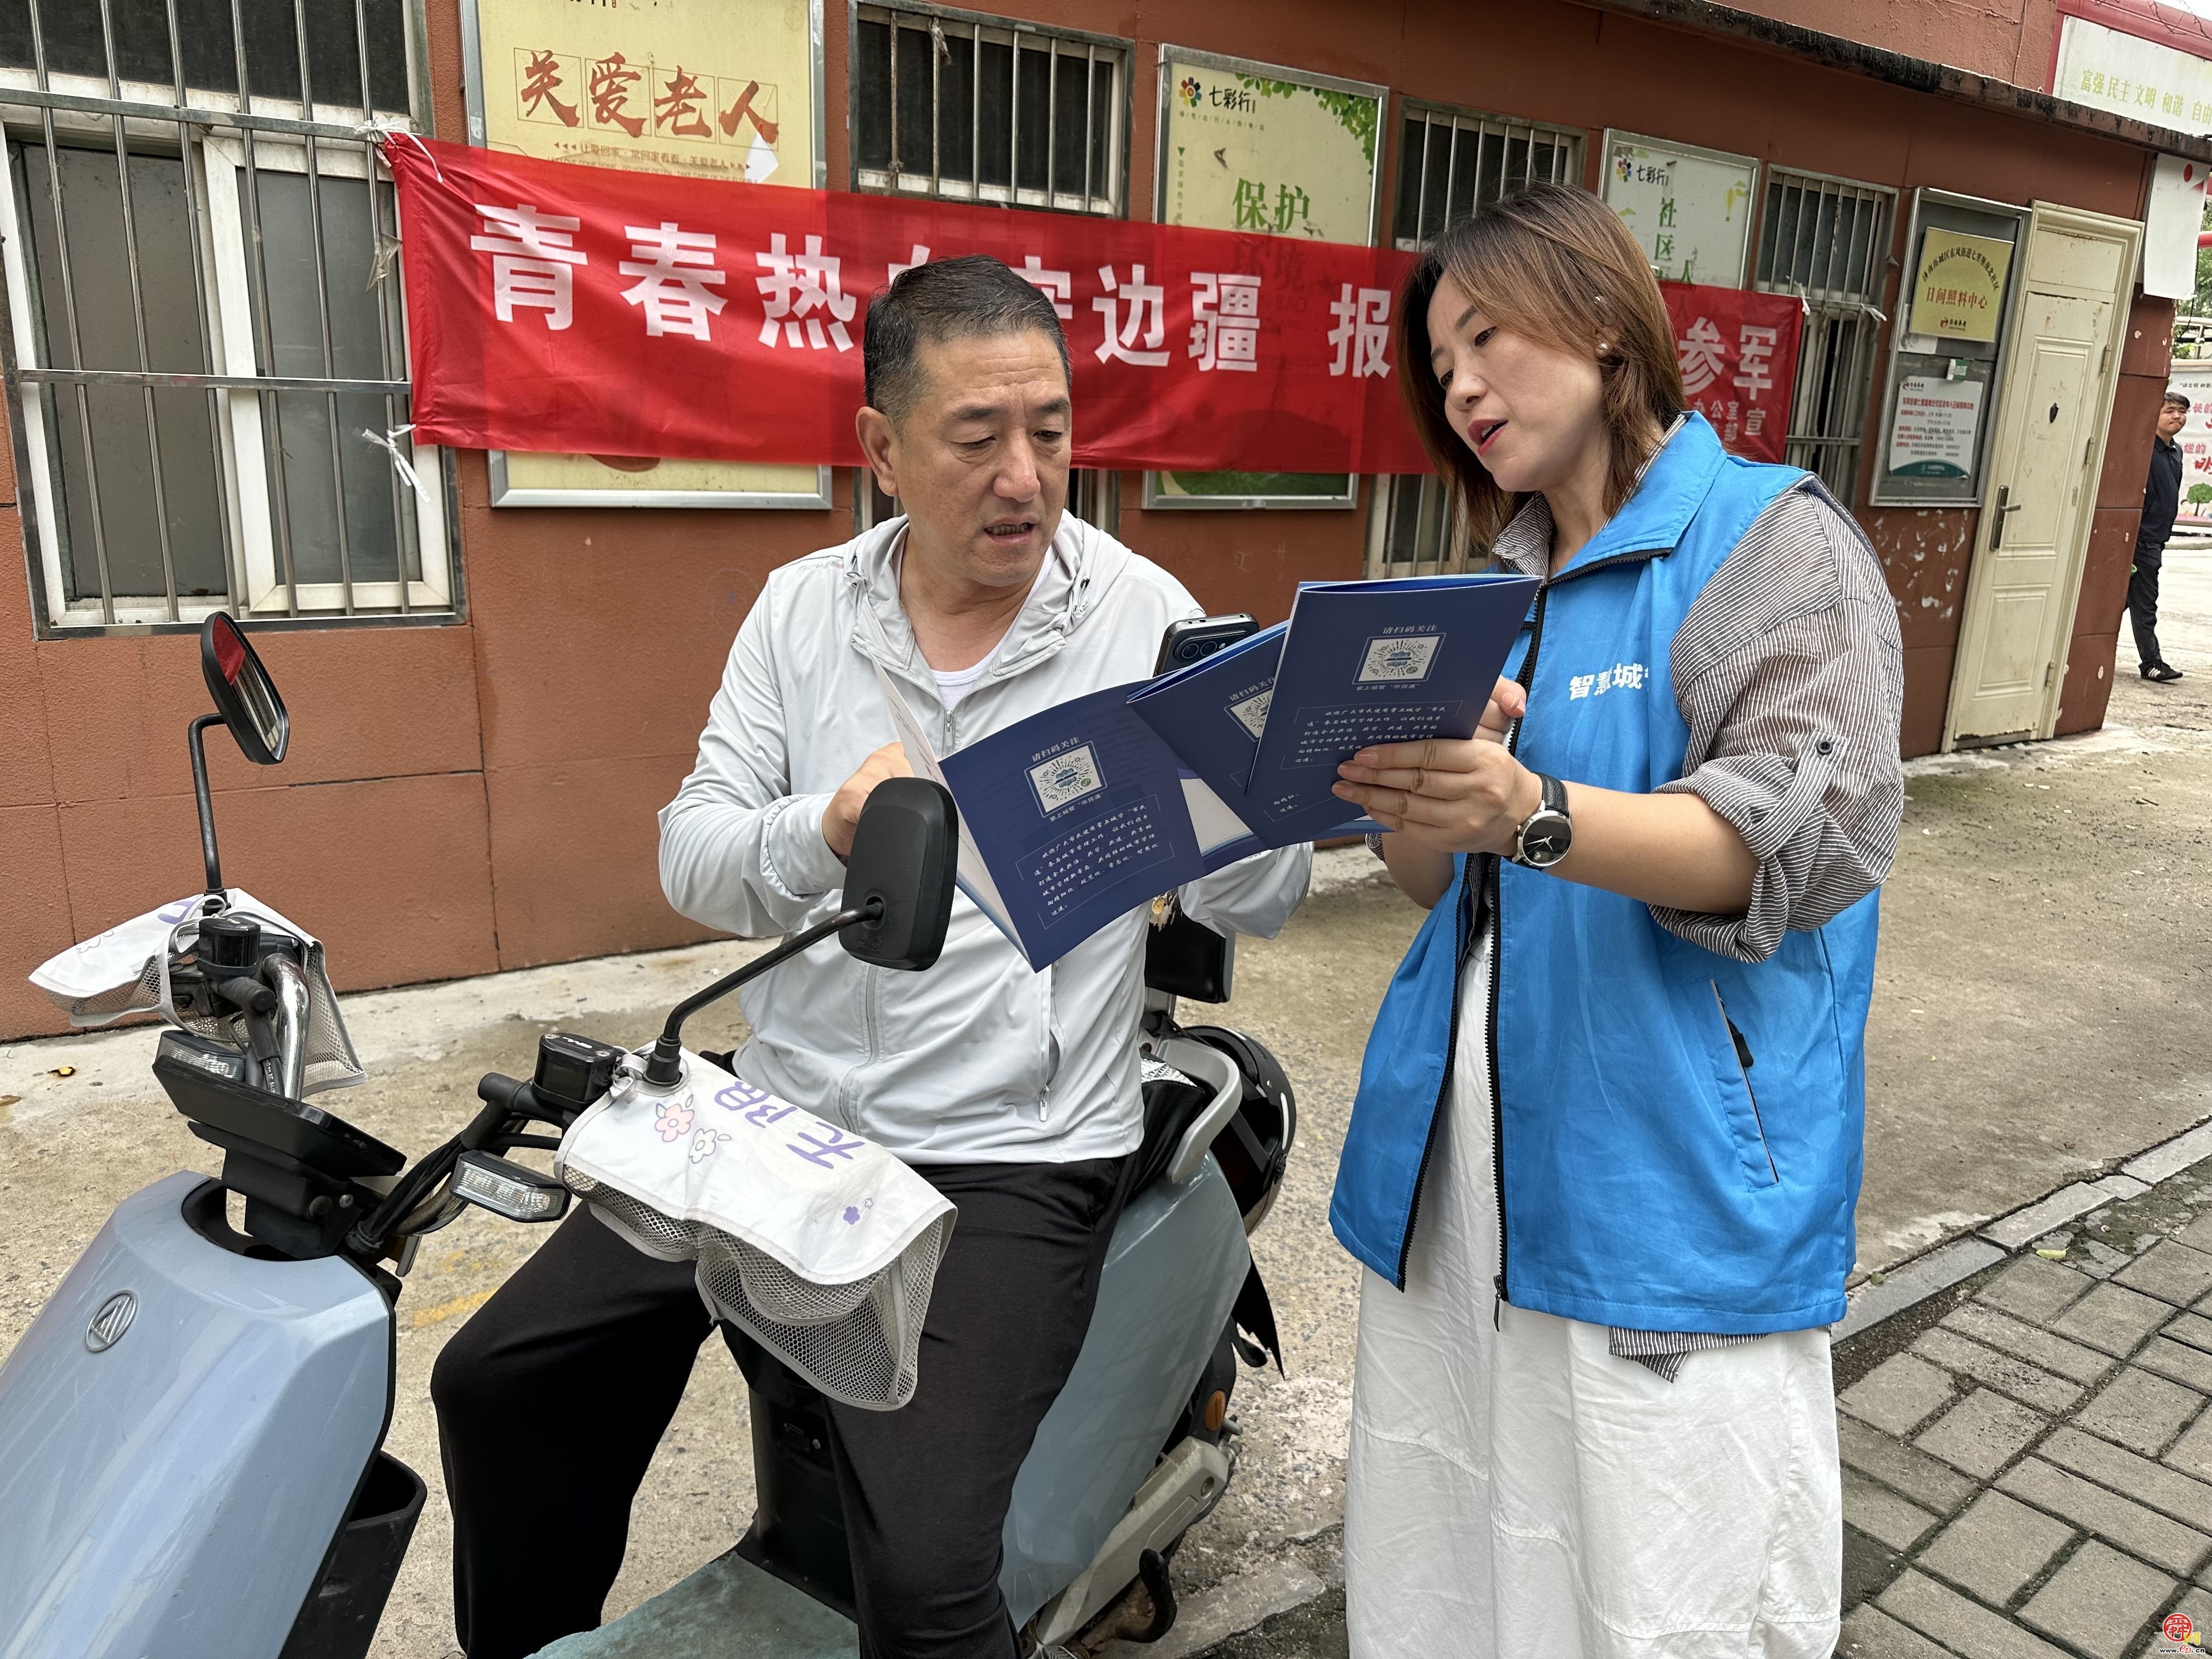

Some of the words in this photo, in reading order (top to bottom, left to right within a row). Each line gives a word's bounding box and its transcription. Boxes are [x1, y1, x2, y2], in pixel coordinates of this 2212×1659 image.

[521, 50, 779, 144] 关爱老人
[1209, 85, 1253, 113] 七彩行
[2081, 69, 2105, 95] 富强
[2107, 76, 2131, 103] 民主
[2133, 84, 2157, 109] 文明
[2162, 92, 2184, 117] 和谐
[2191, 101, 2212, 126] 自由
[631, 149, 680, 165] 常回家看看
[1232, 178, 1310, 233] 保护
[1926, 286, 1988, 309] 日间照料中心
[1678, 317, 1777, 400] 参军
[1383, 624, 1437, 634] 请扫码关注
[1568, 663, 1649, 701] 智慧城
[1031, 736, 1080, 762] 请扫码关注
